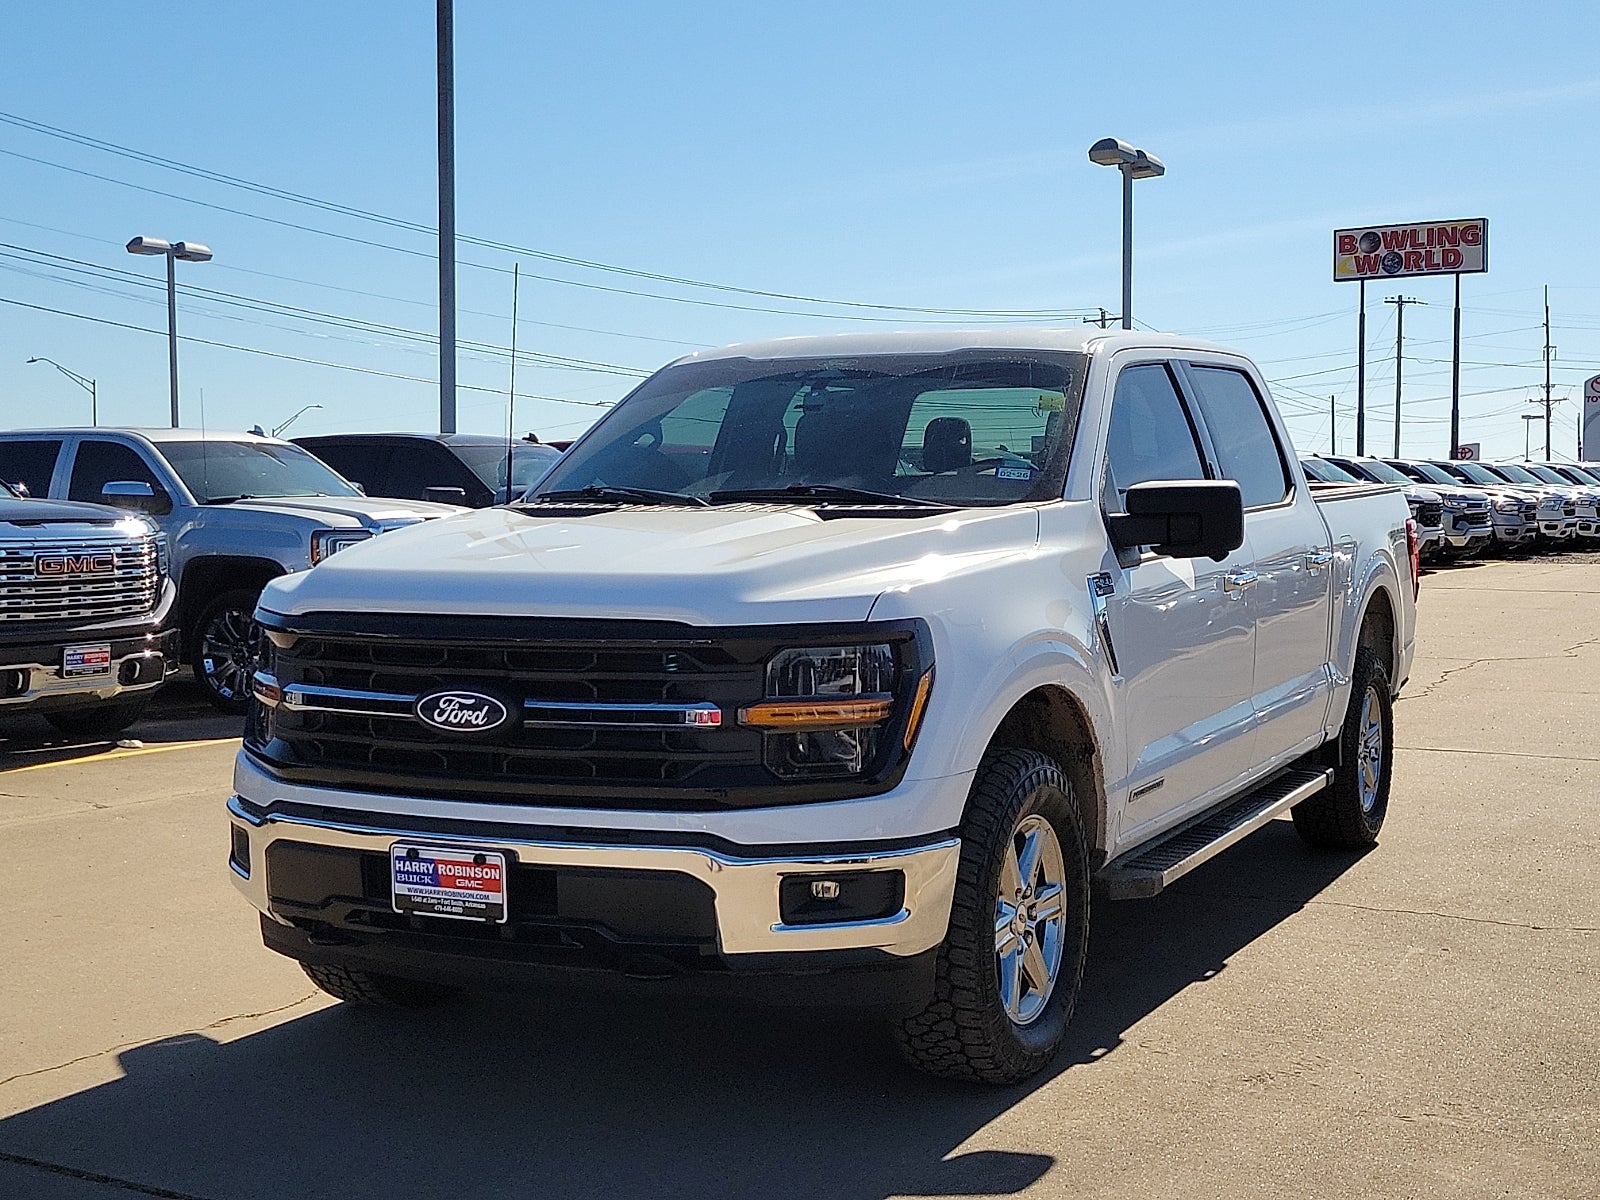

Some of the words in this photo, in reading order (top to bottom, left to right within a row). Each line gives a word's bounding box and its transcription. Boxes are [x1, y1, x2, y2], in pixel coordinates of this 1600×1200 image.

[1338, 224, 1481, 256] BOWLING
[1354, 248, 1463, 275] WORLD
[39, 555, 112, 574] GMC
[433, 696, 489, 725] Ford
[395, 860, 435, 874] HARRY
[438, 863, 500, 880] ROBINSON
[396, 873, 433, 884] BUICK
[455, 879, 484, 889] GMC
[406, 887, 490, 901] WWW.HARRYROBINSON.COM
